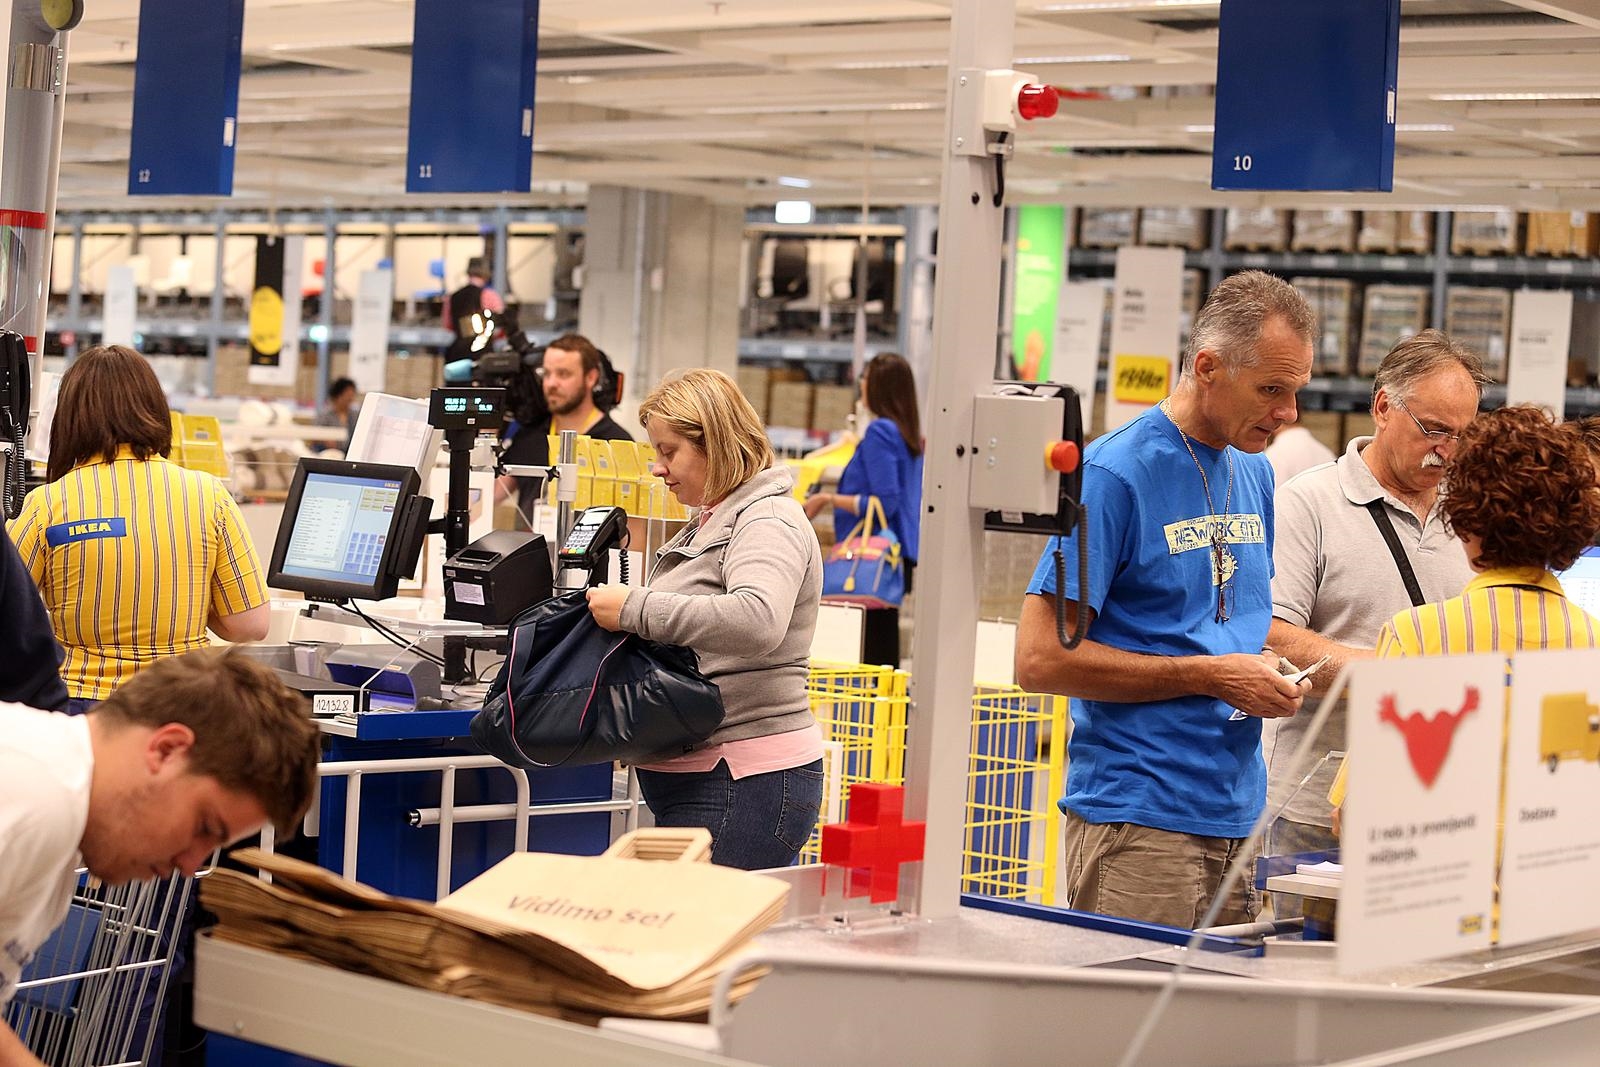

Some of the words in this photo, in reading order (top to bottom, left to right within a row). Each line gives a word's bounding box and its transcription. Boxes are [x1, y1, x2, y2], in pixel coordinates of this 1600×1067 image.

[1234, 155, 1252, 171] 10
[68, 521, 112, 536] IKEA
[317, 699, 349, 711] 121328
[508, 896, 613, 922] Vidimo
[619, 907, 676, 929] se!
